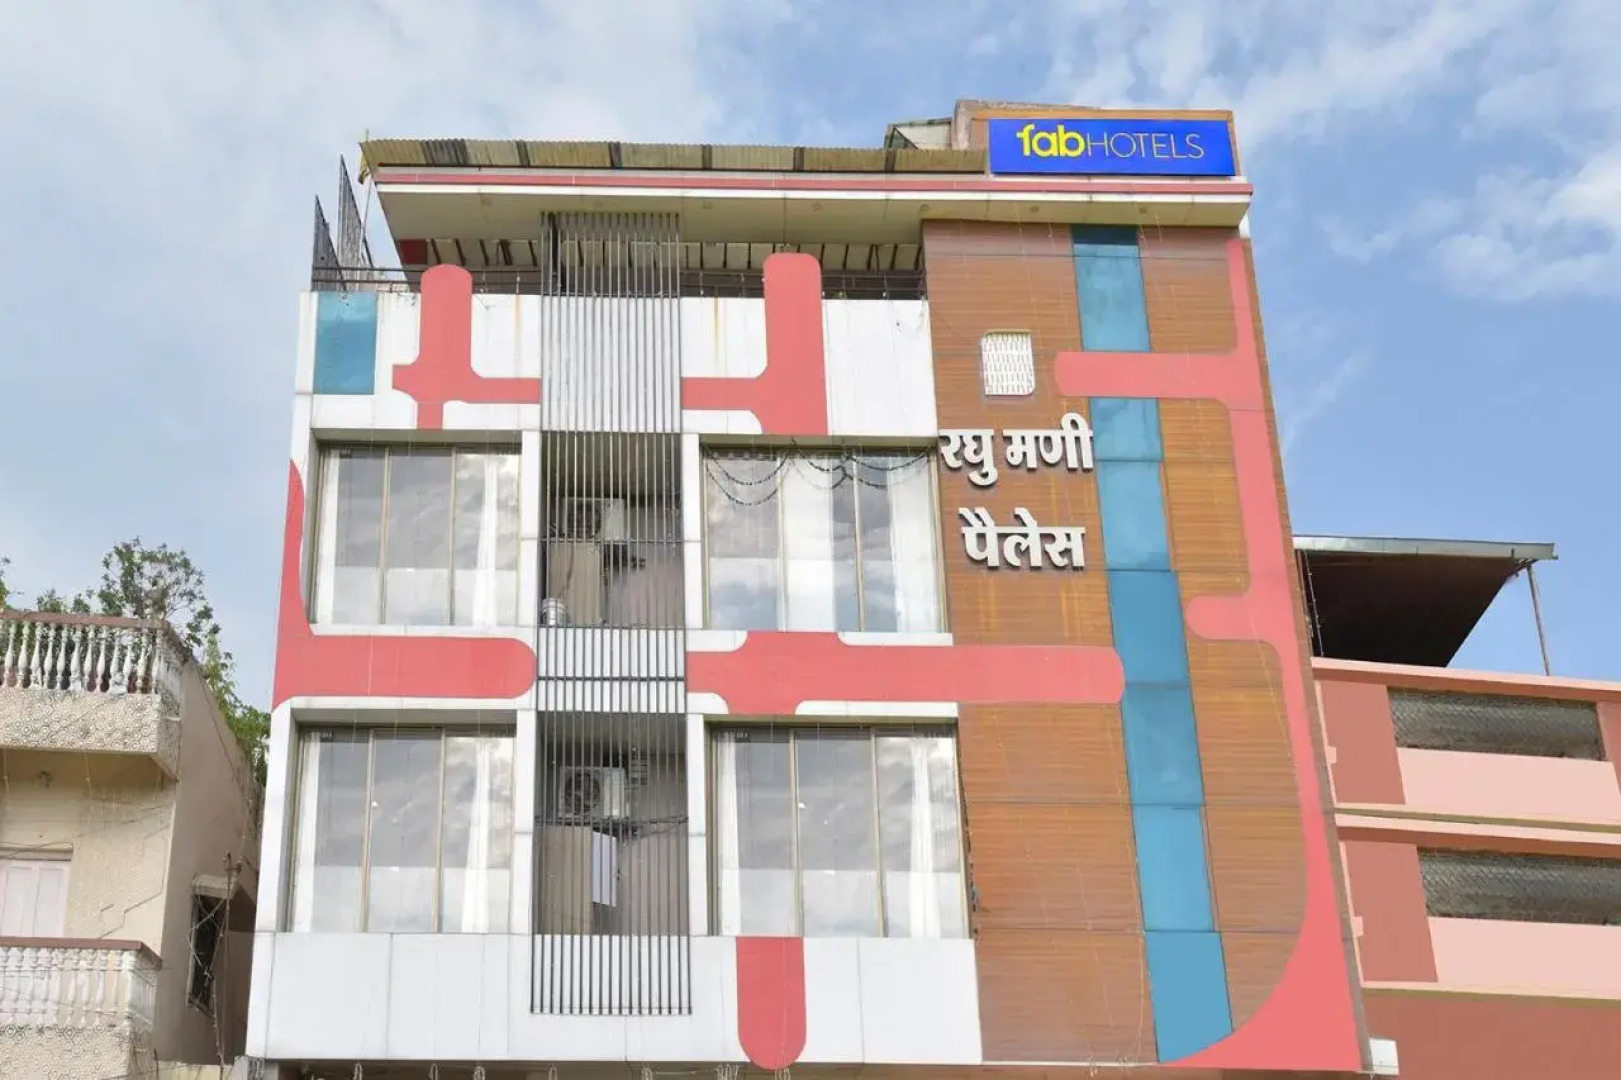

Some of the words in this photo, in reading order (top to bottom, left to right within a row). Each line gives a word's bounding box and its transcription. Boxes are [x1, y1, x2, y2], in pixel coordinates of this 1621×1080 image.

[939, 428, 999, 487] रघु
[1002, 412, 1094, 472] मणी
[958, 507, 1086, 568] पैलेस
